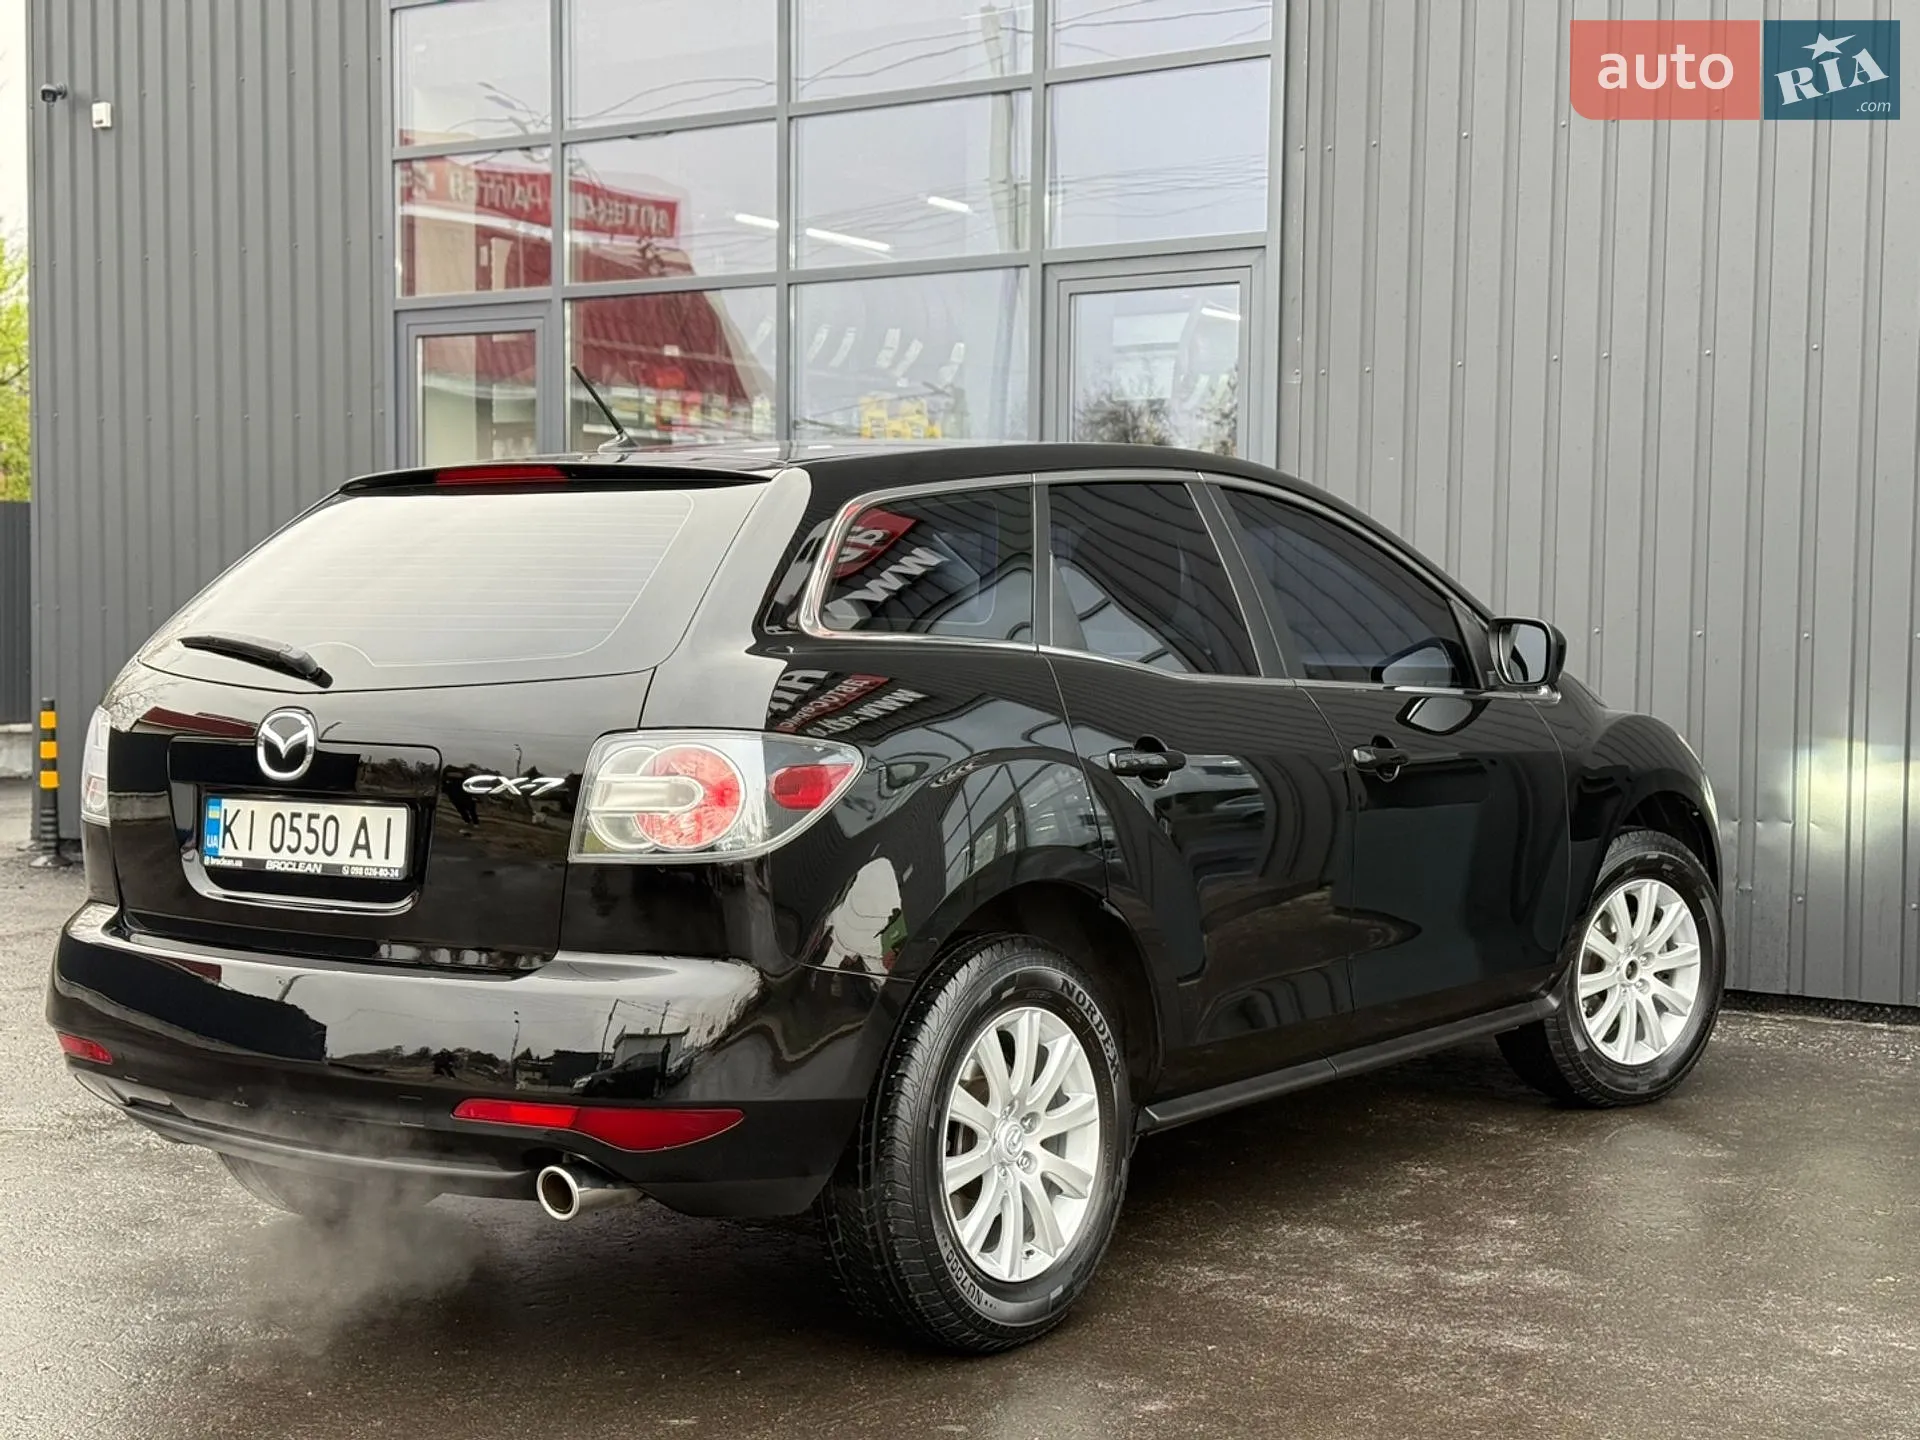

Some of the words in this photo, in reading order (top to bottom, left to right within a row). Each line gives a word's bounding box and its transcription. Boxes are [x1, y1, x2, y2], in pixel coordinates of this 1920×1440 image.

[462, 775, 565, 796] CX-7
[206, 834, 219, 849] UA
[221, 808, 255, 852] KI
[269, 811, 340, 857] 0550
[349, 816, 393, 861] AI
[265, 859, 323, 874] BROCLEAN
